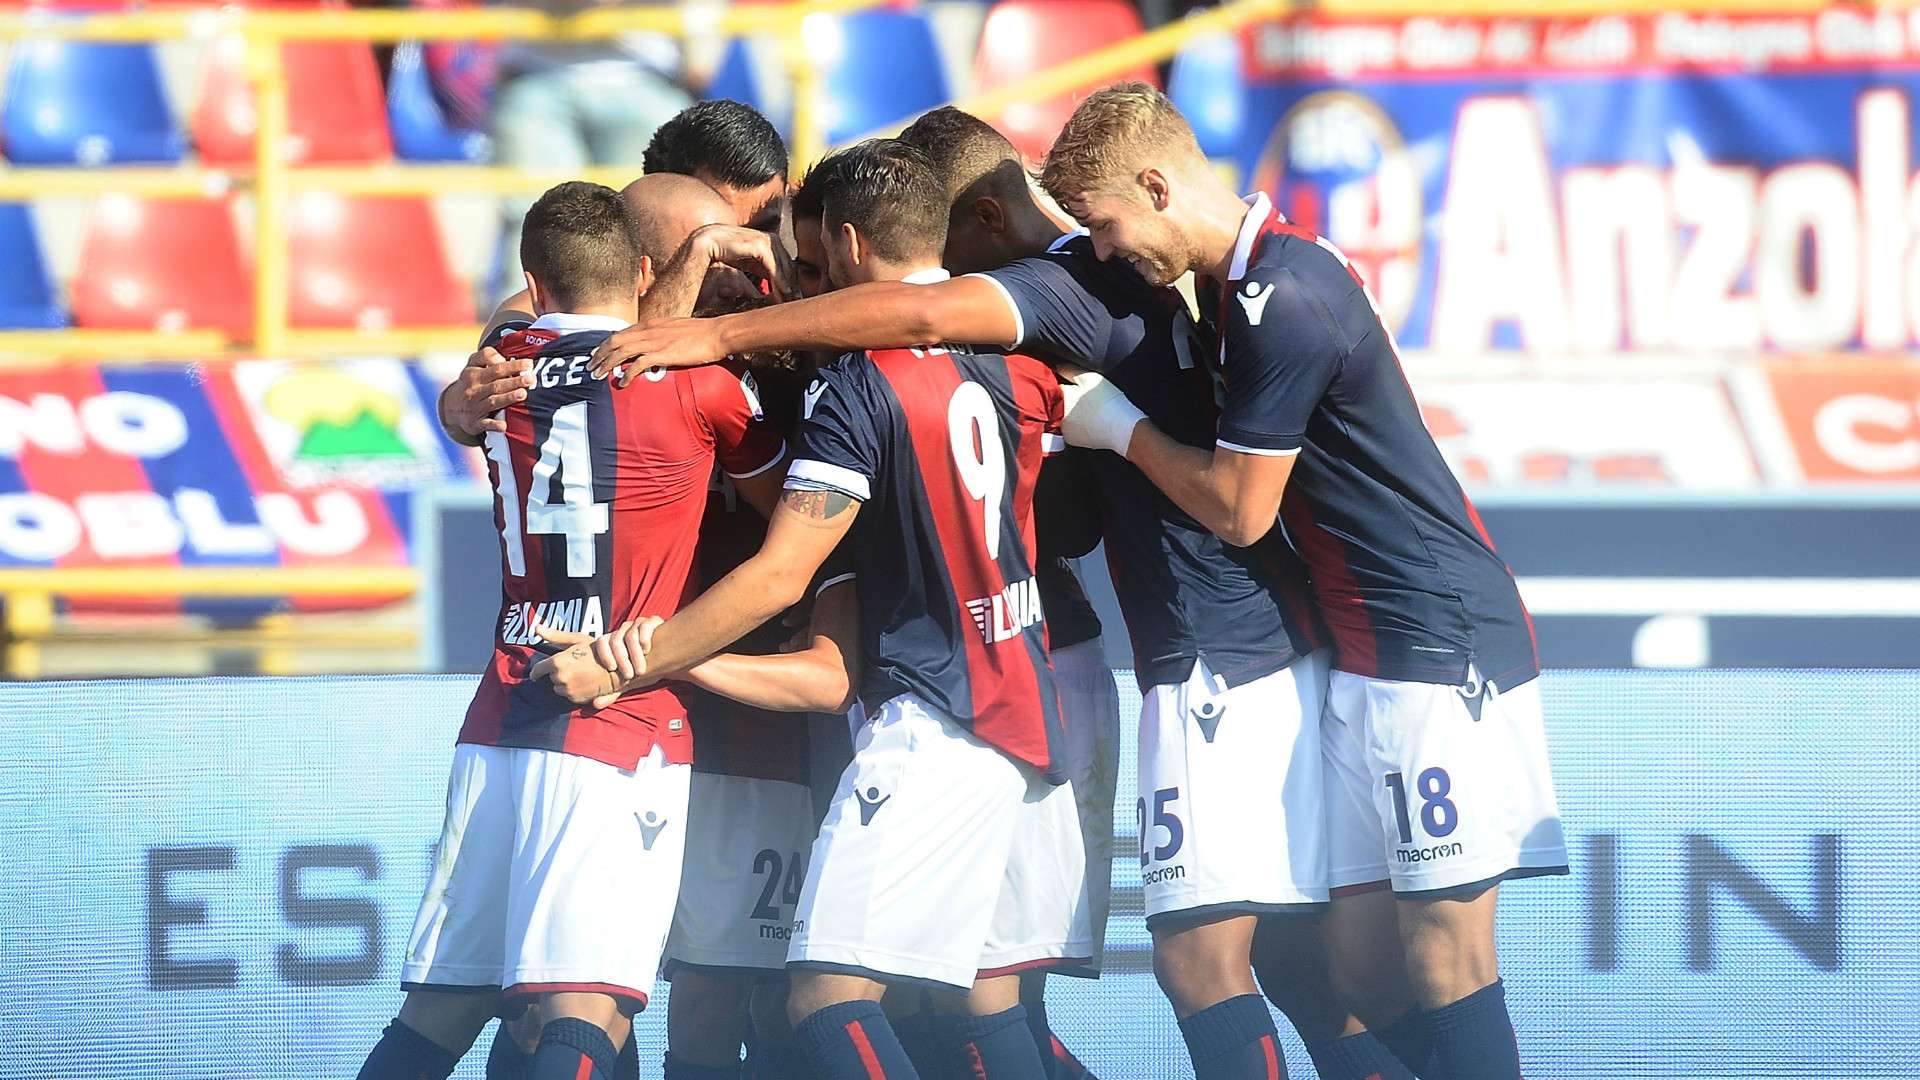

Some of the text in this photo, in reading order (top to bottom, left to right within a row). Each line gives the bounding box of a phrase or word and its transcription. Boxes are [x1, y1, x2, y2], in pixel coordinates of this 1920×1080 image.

[1430, 88, 1920, 353] Anzol
[484, 401, 609, 577] 14
[948, 380, 1006, 560] 9
[1384, 767, 1458, 844] 18
[1396, 842, 1463, 863] macron
[750, 848, 806, 920] 24
